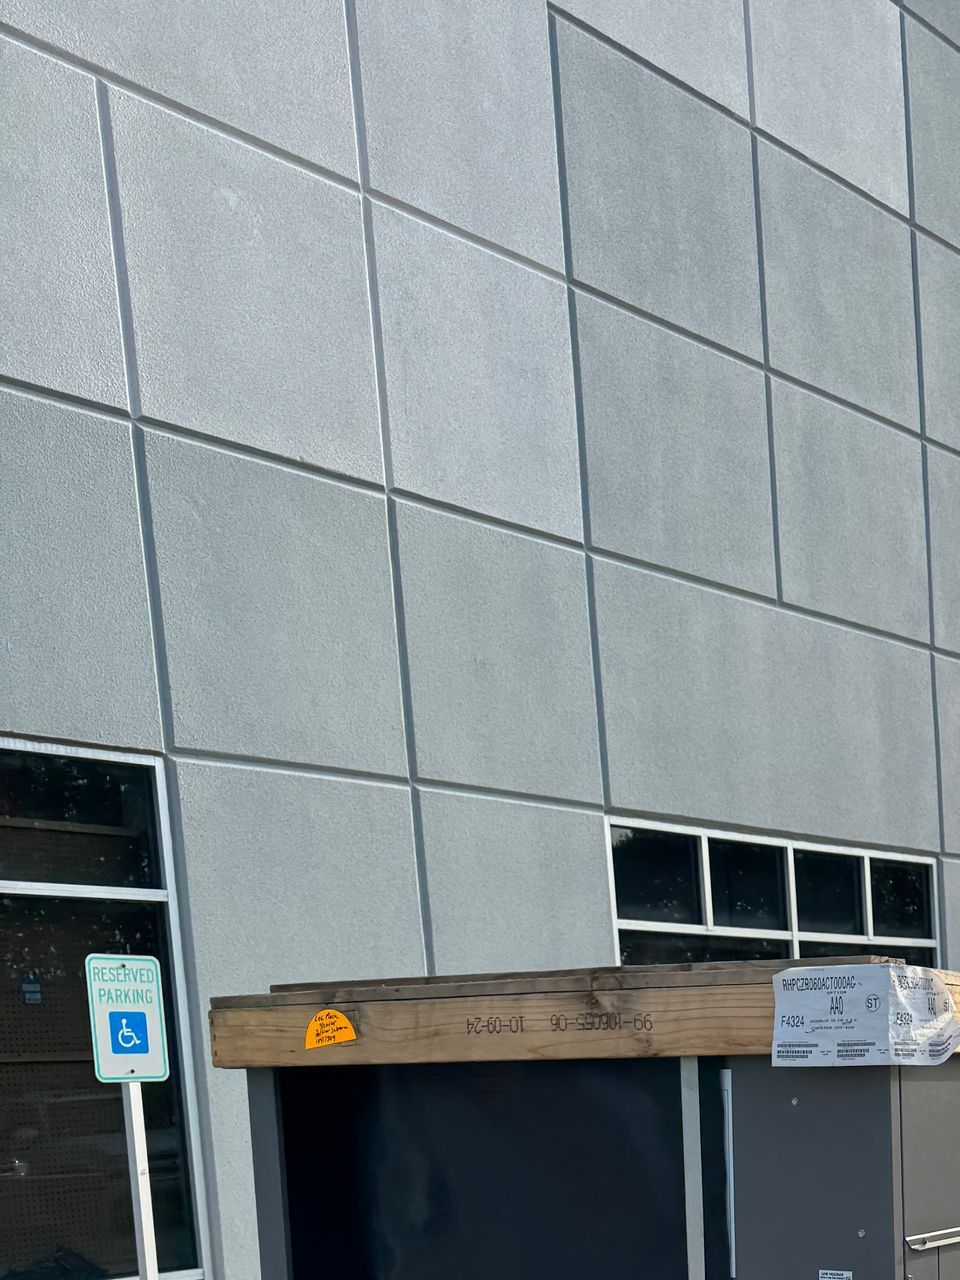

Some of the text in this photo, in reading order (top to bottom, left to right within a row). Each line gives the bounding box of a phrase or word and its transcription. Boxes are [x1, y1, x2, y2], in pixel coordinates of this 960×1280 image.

[92, 966, 155, 983] RESERVED
[98, 988, 153, 1005] PARKING
[466, 1015, 525, 1035] 10-09-24
[781, 1015, 805, 1028] F4324
